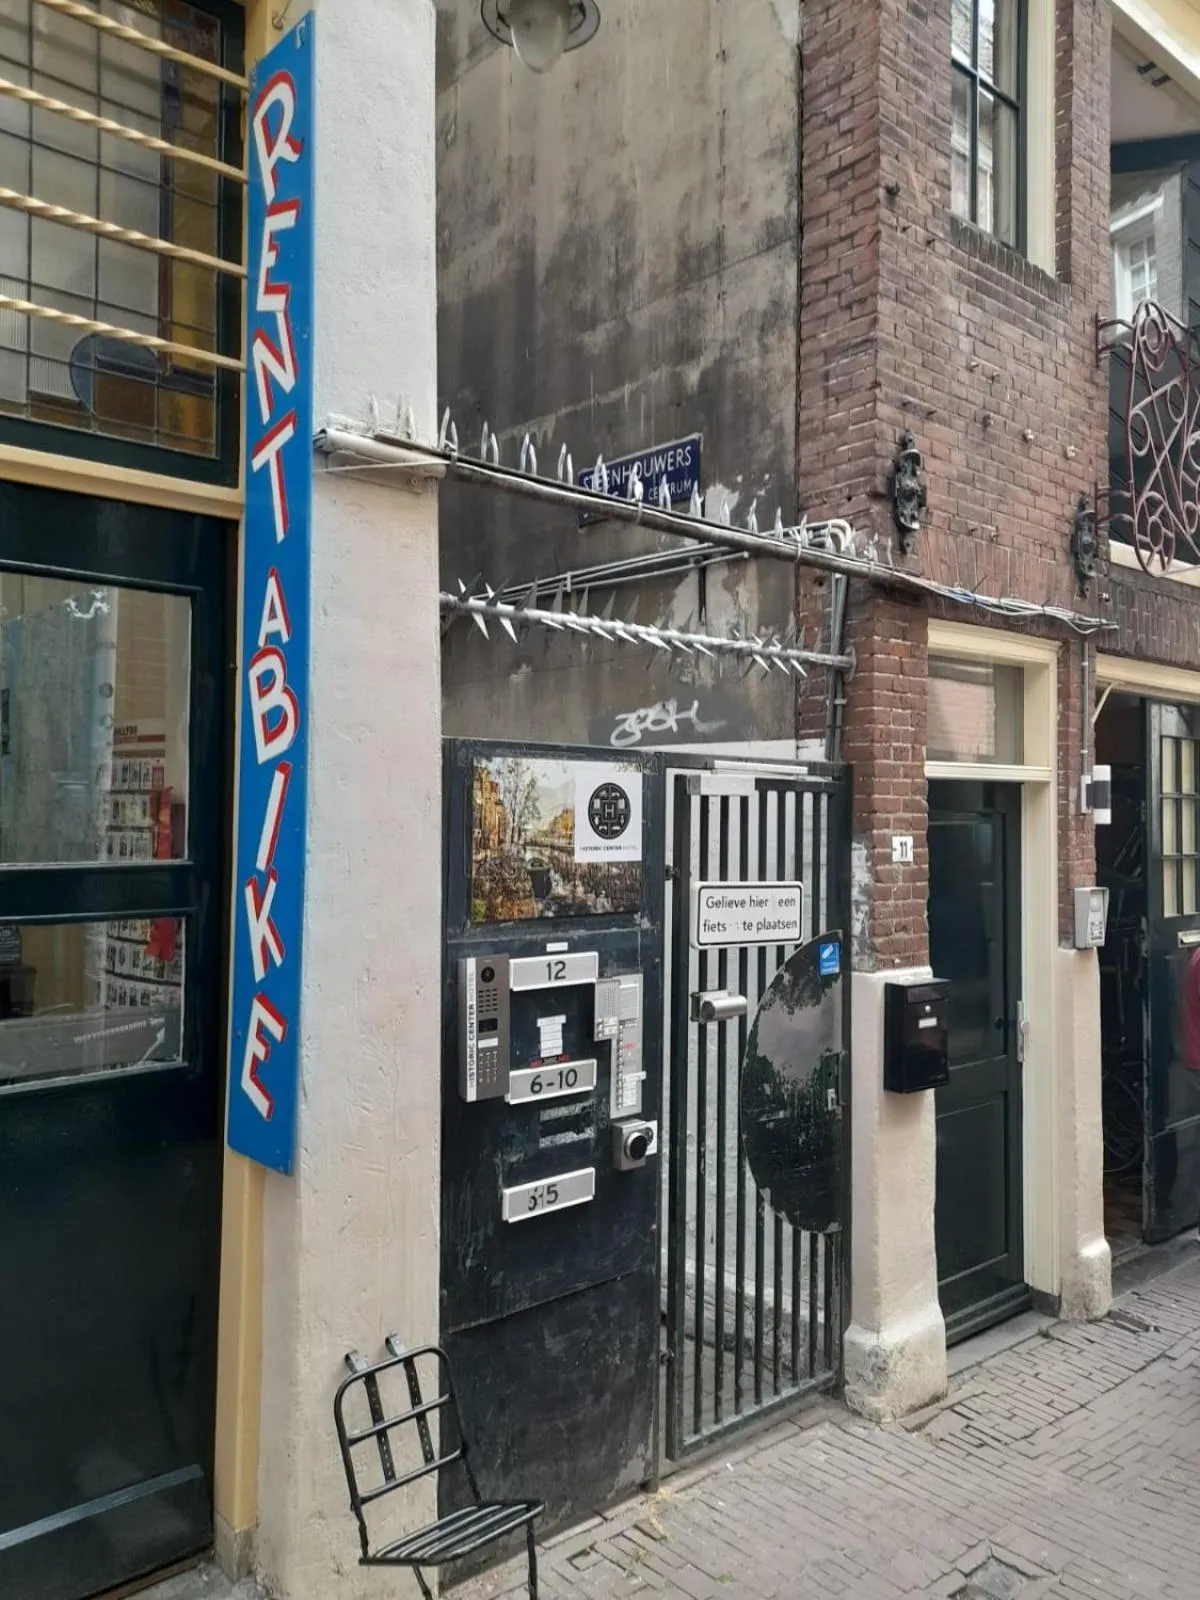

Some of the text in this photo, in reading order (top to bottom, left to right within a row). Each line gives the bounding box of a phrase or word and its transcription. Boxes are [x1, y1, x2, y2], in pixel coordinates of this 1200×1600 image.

[252, 70, 303, 544] RENT
[899, 840, 908, 859] 11
[706, 896, 746, 909] Gelieve
[749, 895, 768, 908] hier
[743, 920, 753, 931] te
[756, 917, 797, 933] plaatsen
[545, 960, 566, 981] 12
[468, 1003, 476, 1041] CENTER
[530, 1068, 577, 1093] 6-10
